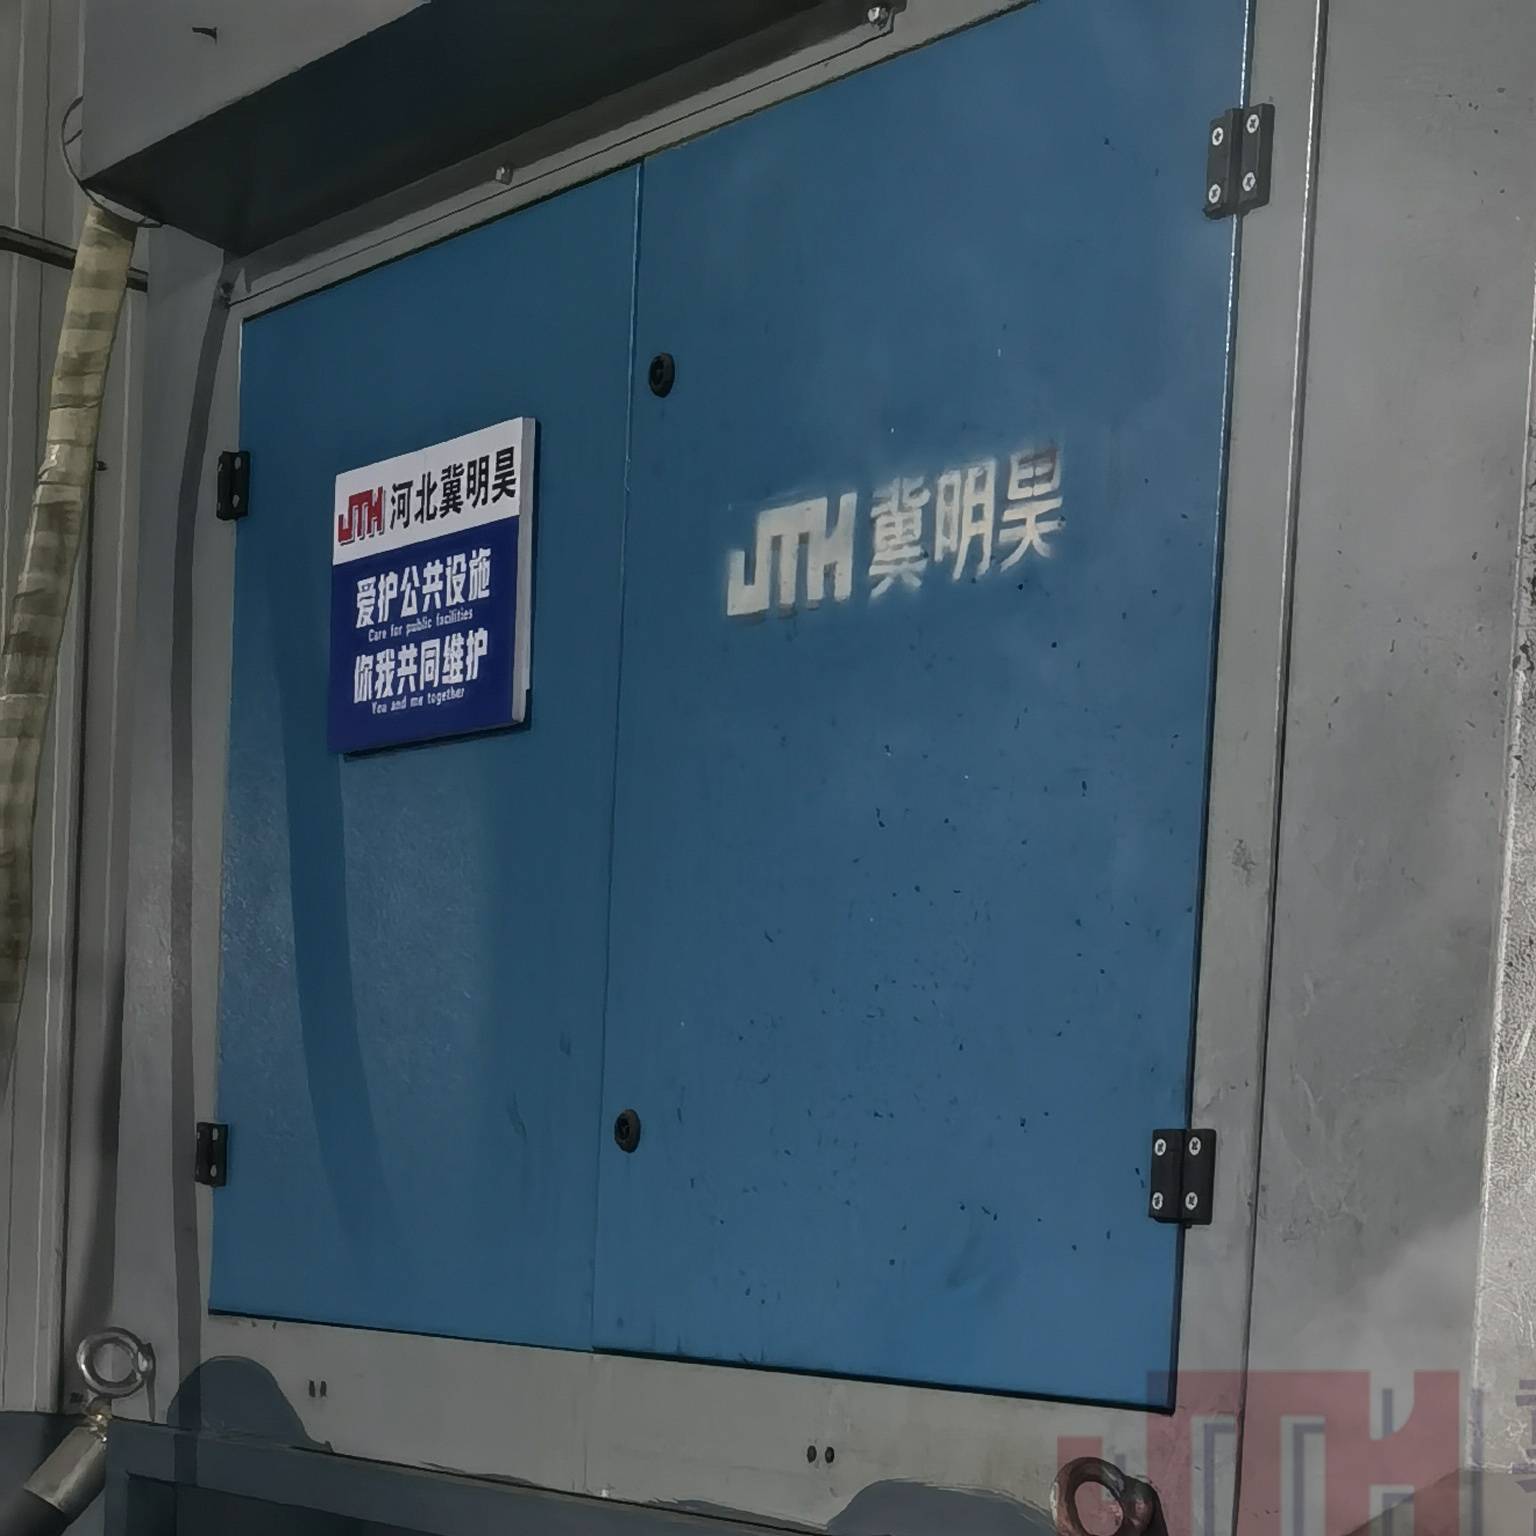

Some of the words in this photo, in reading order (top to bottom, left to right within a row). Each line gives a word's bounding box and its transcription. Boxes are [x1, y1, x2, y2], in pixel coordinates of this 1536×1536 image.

[390, 446, 516, 530] 河北冀明昊
[868, 448, 1065, 598] 冀明昊
[355, 547, 491, 629] 爱护公共设施
[368, 628, 387, 642] Care
[390, 624, 403, 637] for
[406, 616, 432, 637] public
[436, 608, 473, 627] facilities
[354, 627, 489, 704] 你我共同维护
[372, 701, 387, 715] You
[390, 696, 406, 711] and
[410, 696, 423, 707] me
[427, 686, 465, 706] together
